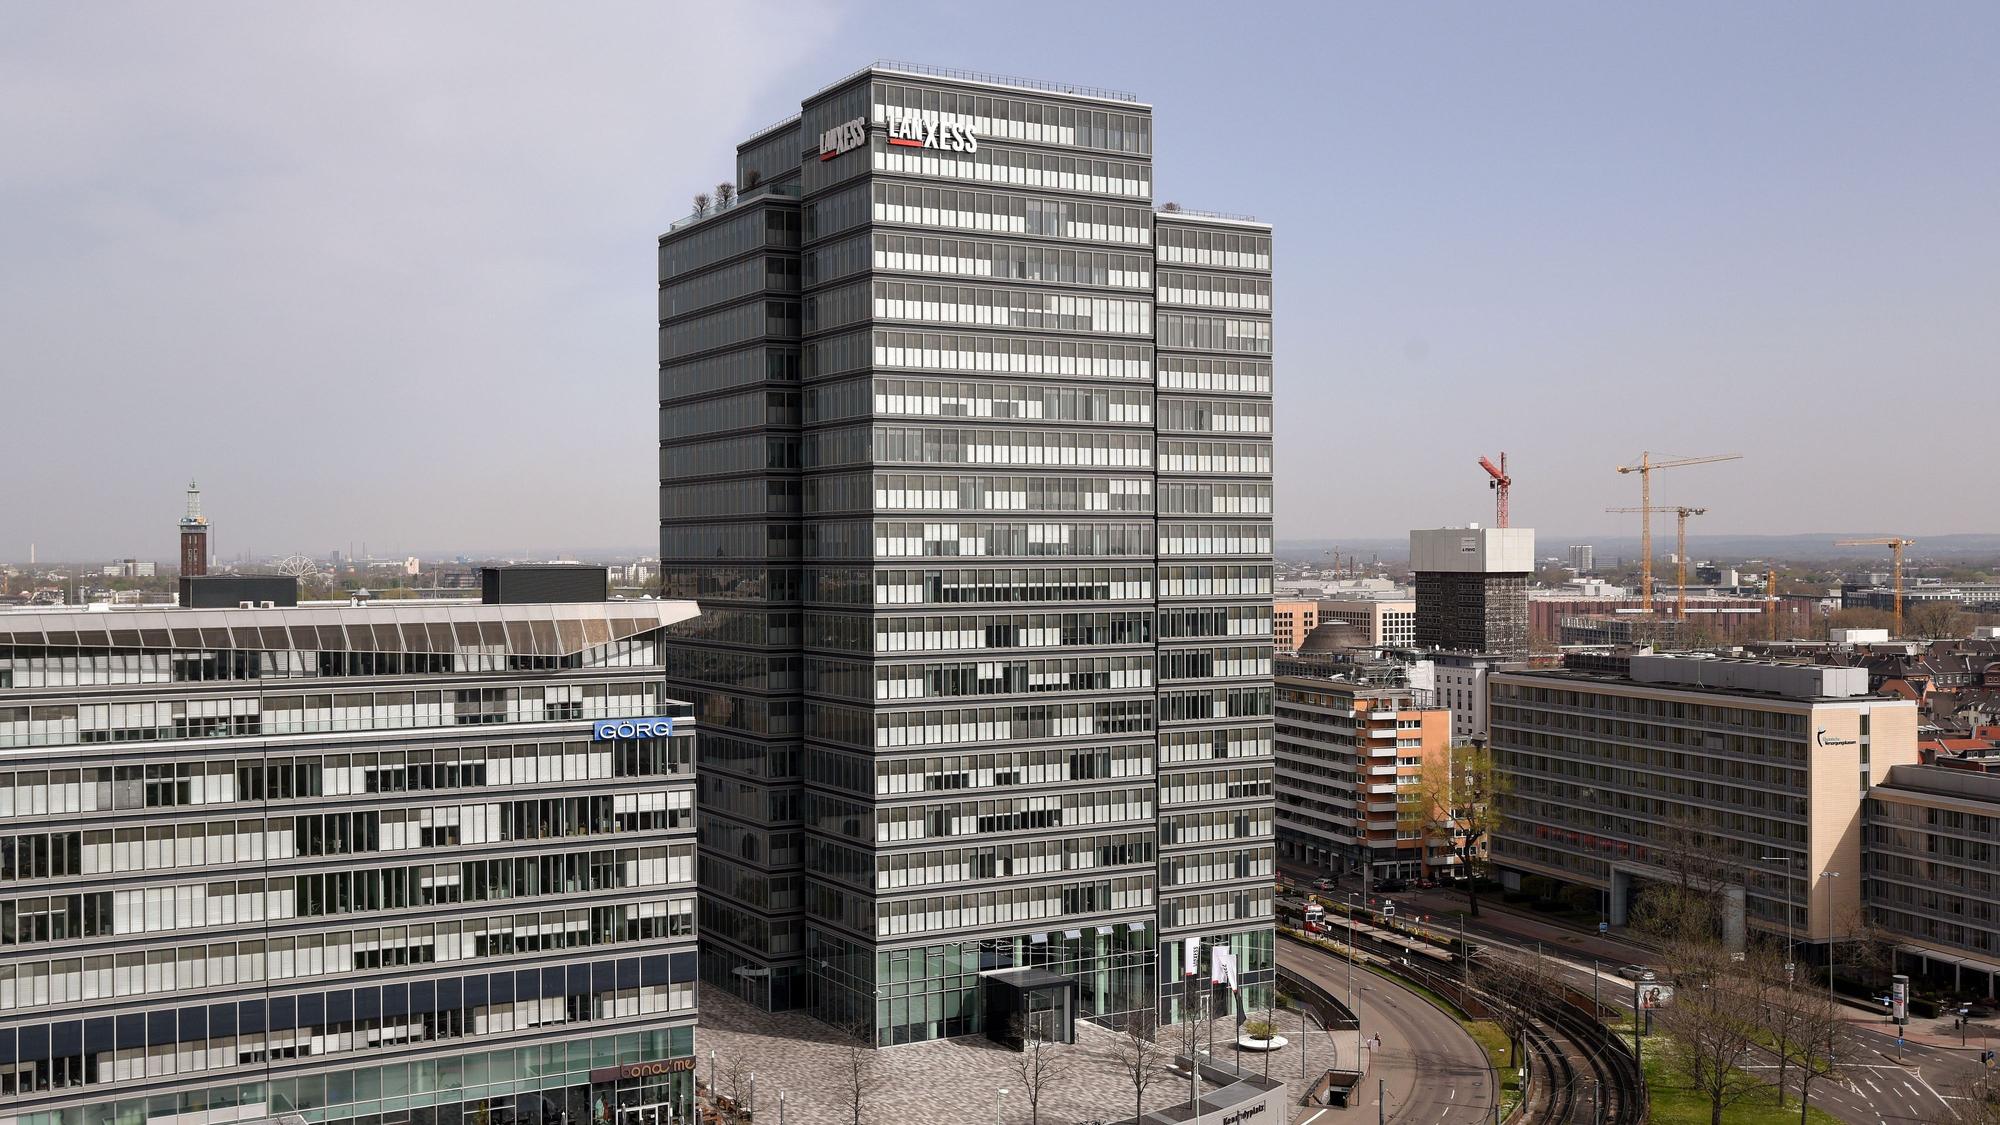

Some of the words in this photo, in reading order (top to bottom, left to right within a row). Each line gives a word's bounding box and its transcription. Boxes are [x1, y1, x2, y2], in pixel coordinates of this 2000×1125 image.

[819, 117, 865, 154] LANXESS
[886, 115, 977, 153] LANXESS
[600, 721, 669, 739] GÖRG
